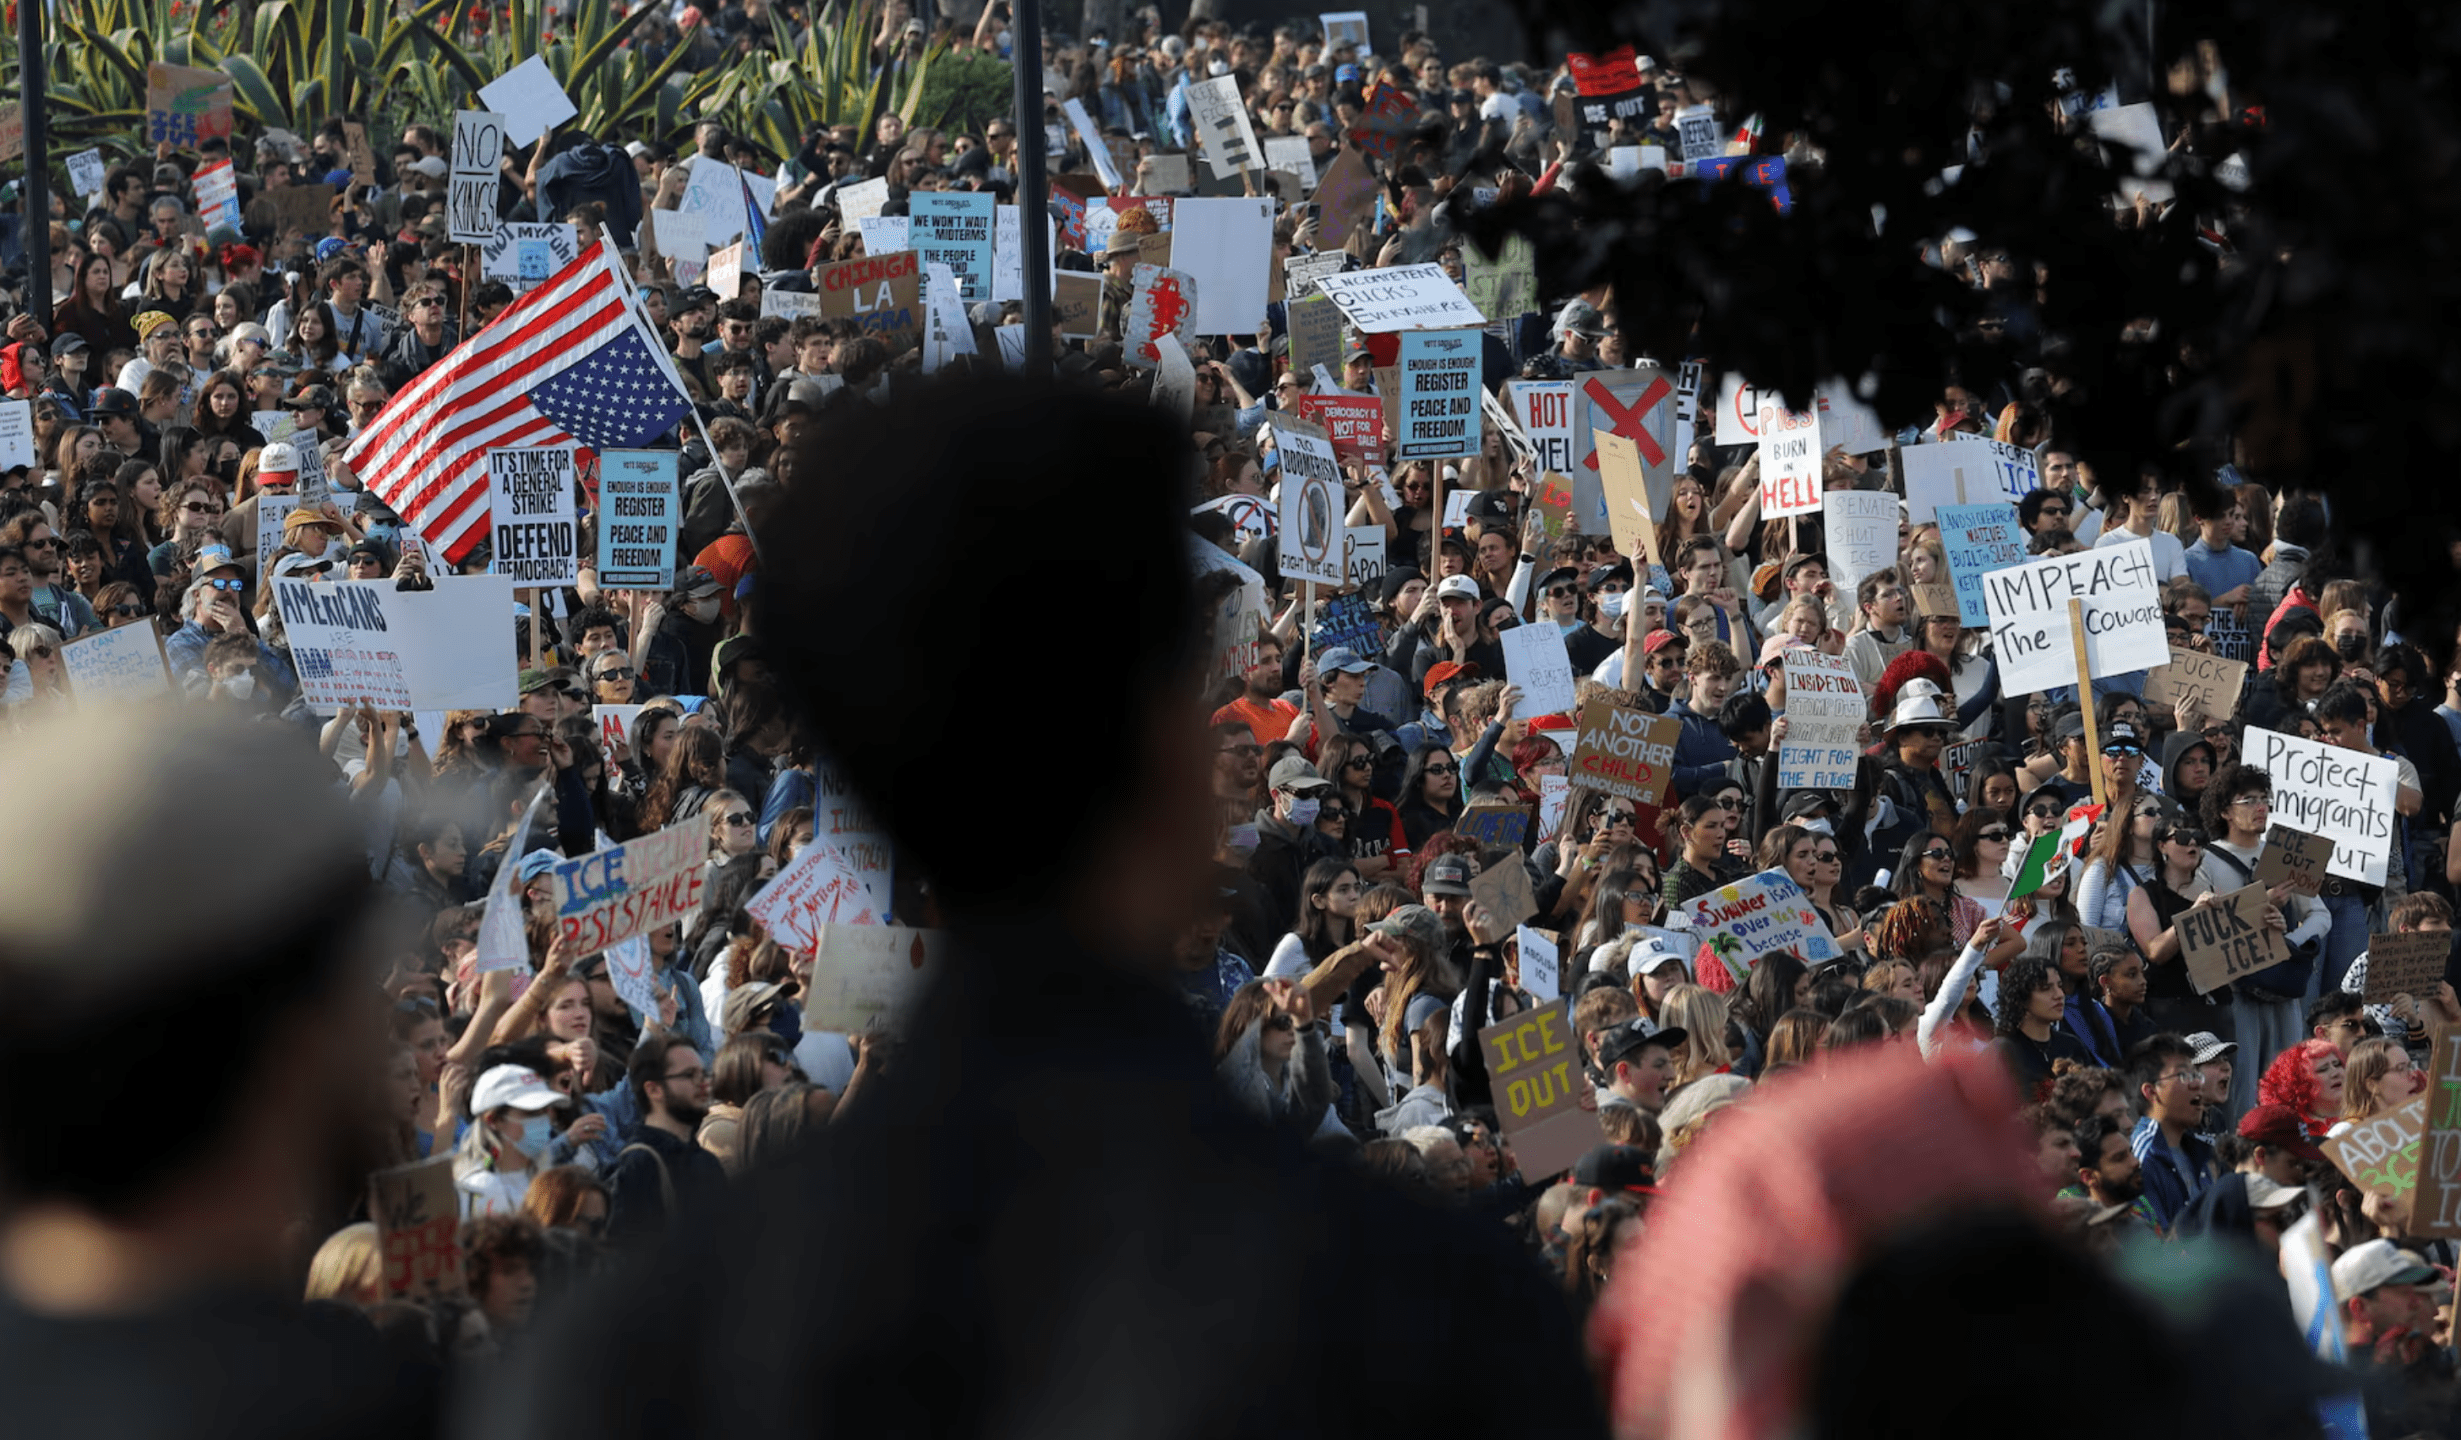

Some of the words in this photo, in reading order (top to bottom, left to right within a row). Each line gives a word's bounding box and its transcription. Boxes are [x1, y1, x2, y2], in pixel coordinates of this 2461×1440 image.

[1615, 96, 1645, 118] OUT
[151, 109, 197, 130] ICE
[152, 129, 198, 147] OUT
[457, 122, 498, 168] NO
[453, 181, 498, 232] KINGS
[914, 215, 928, 227] WE
[932, 215, 961, 228] WON'T
[965, 216, 988, 228] WAIT
[483, 223, 515, 262] NOT
[518, 226, 542, 239] MY
[935, 228, 986, 241] MIDTERMS
[924, 250, 940, 262] THE
[943, 250, 975, 262] PEOPLE
[825, 252, 918, 292] CHINGA
[1318, 265, 1442, 292] INCOMPETENT
[853, 281, 894, 313] LA
[1332, 284, 1418, 308] CUCKS
[1350, 301, 1468, 325] EVERYWHERE
[1408, 359, 1438, 371] ENOUGH
[1439, 358, 1446, 370] IS
[1448, 357, 1476, 370] ENOUGH!
[1415, 372, 1468, 392] REGISTER
[1325, 407, 1368, 419] DEMOCRACY
[1370, 408, 1377, 419] IS
[1411, 399, 1447, 417] PEACE
[1450, 397, 1471, 415] AND
[1529, 392, 1569, 428] HOT
[1334, 421, 1354, 434] NOT
[1357, 421, 1371, 432] FOR
[1412, 419, 1465, 439] FREEDOM
[1357, 435, 1377, 447] SALE!
[1773, 438, 1807, 460] BURN
[492, 452, 516, 474] IT'S
[518, 451, 547, 472] TIME
[548, 450, 569, 471] FOR
[1282, 448, 1342, 484] DOOMERISM
[1989, 440, 2035, 470] SECRET
[1784, 463, 1793, 472] IN
[503, 474, 511, 494] A
[513, 471, 563, 493] GENERAL
[607, 481, 635, 493] ENOUGH
[637, 482, 644, 493] IS
[1761, 472, 1820, 511] HELL
[512, 493, 557, 515] STRIKE!
[615, 497, 665, 517] REGISTER
[1835, 494, 1898, 517] SENATE
[498, 522, 572, 560] DEFEND
[610, 525, 644, 544] PEACE
[646, 525, 667, 544] AND
[1834, 525, 1878, 544] SHUT
[1966, 525, 2009, 543] NATIVES
[612, 548, 661, 567] FREEDOM
[1850, 550, 1879, 565] ICE
[1950, 549, 1982, 568] BUILT
[1989, 546, 2154, 616] IMPEACH
[279, 582, 388, 632] AMERICANS
[2210, 610, 2233, 631] THE
[1995, 622, 2051, 664] The
[2208, 631, 2249, 642] SYST
[2168, 652, 2229, 683] FUCK
[1836, 677, 1858, 694] YOU
[2168, 680, 2215, 706] ICE
[1608, 709, 1658, 738] NOT
[1580, 729, 1675, 768] ANOTHER
[1781, 747, 1826, 767] FIGHT
[1828, 749, 1853, 765] FOR
[1780, 771, 1805, 787] THE
[1814, 771, 1855, 788] FUTURE
[2266, 735, 2378, 801] Protect
[2276, 789, 2389, 839] migrants
[2267, 828, 2309, 854] ICE
[2283, 853, 2316, 871] OUT
[2336, 846, 2375, 873] UT
[555, 847, 628, 917] ICE
[2288, 869, 2323, 891] NOW
[2181, 894, 2252, 952] FUCK
[1746, 928, 1802, 954] because
[2221, 928, 2276, 976] ICE!
[1524, 944, 1558, 973] ABOLISH
[1535, 966, 1547, 984] ICE
[1491, 1009, 1565, 1074] ICE
[1507, 1061, 1571, 1118] OUT
